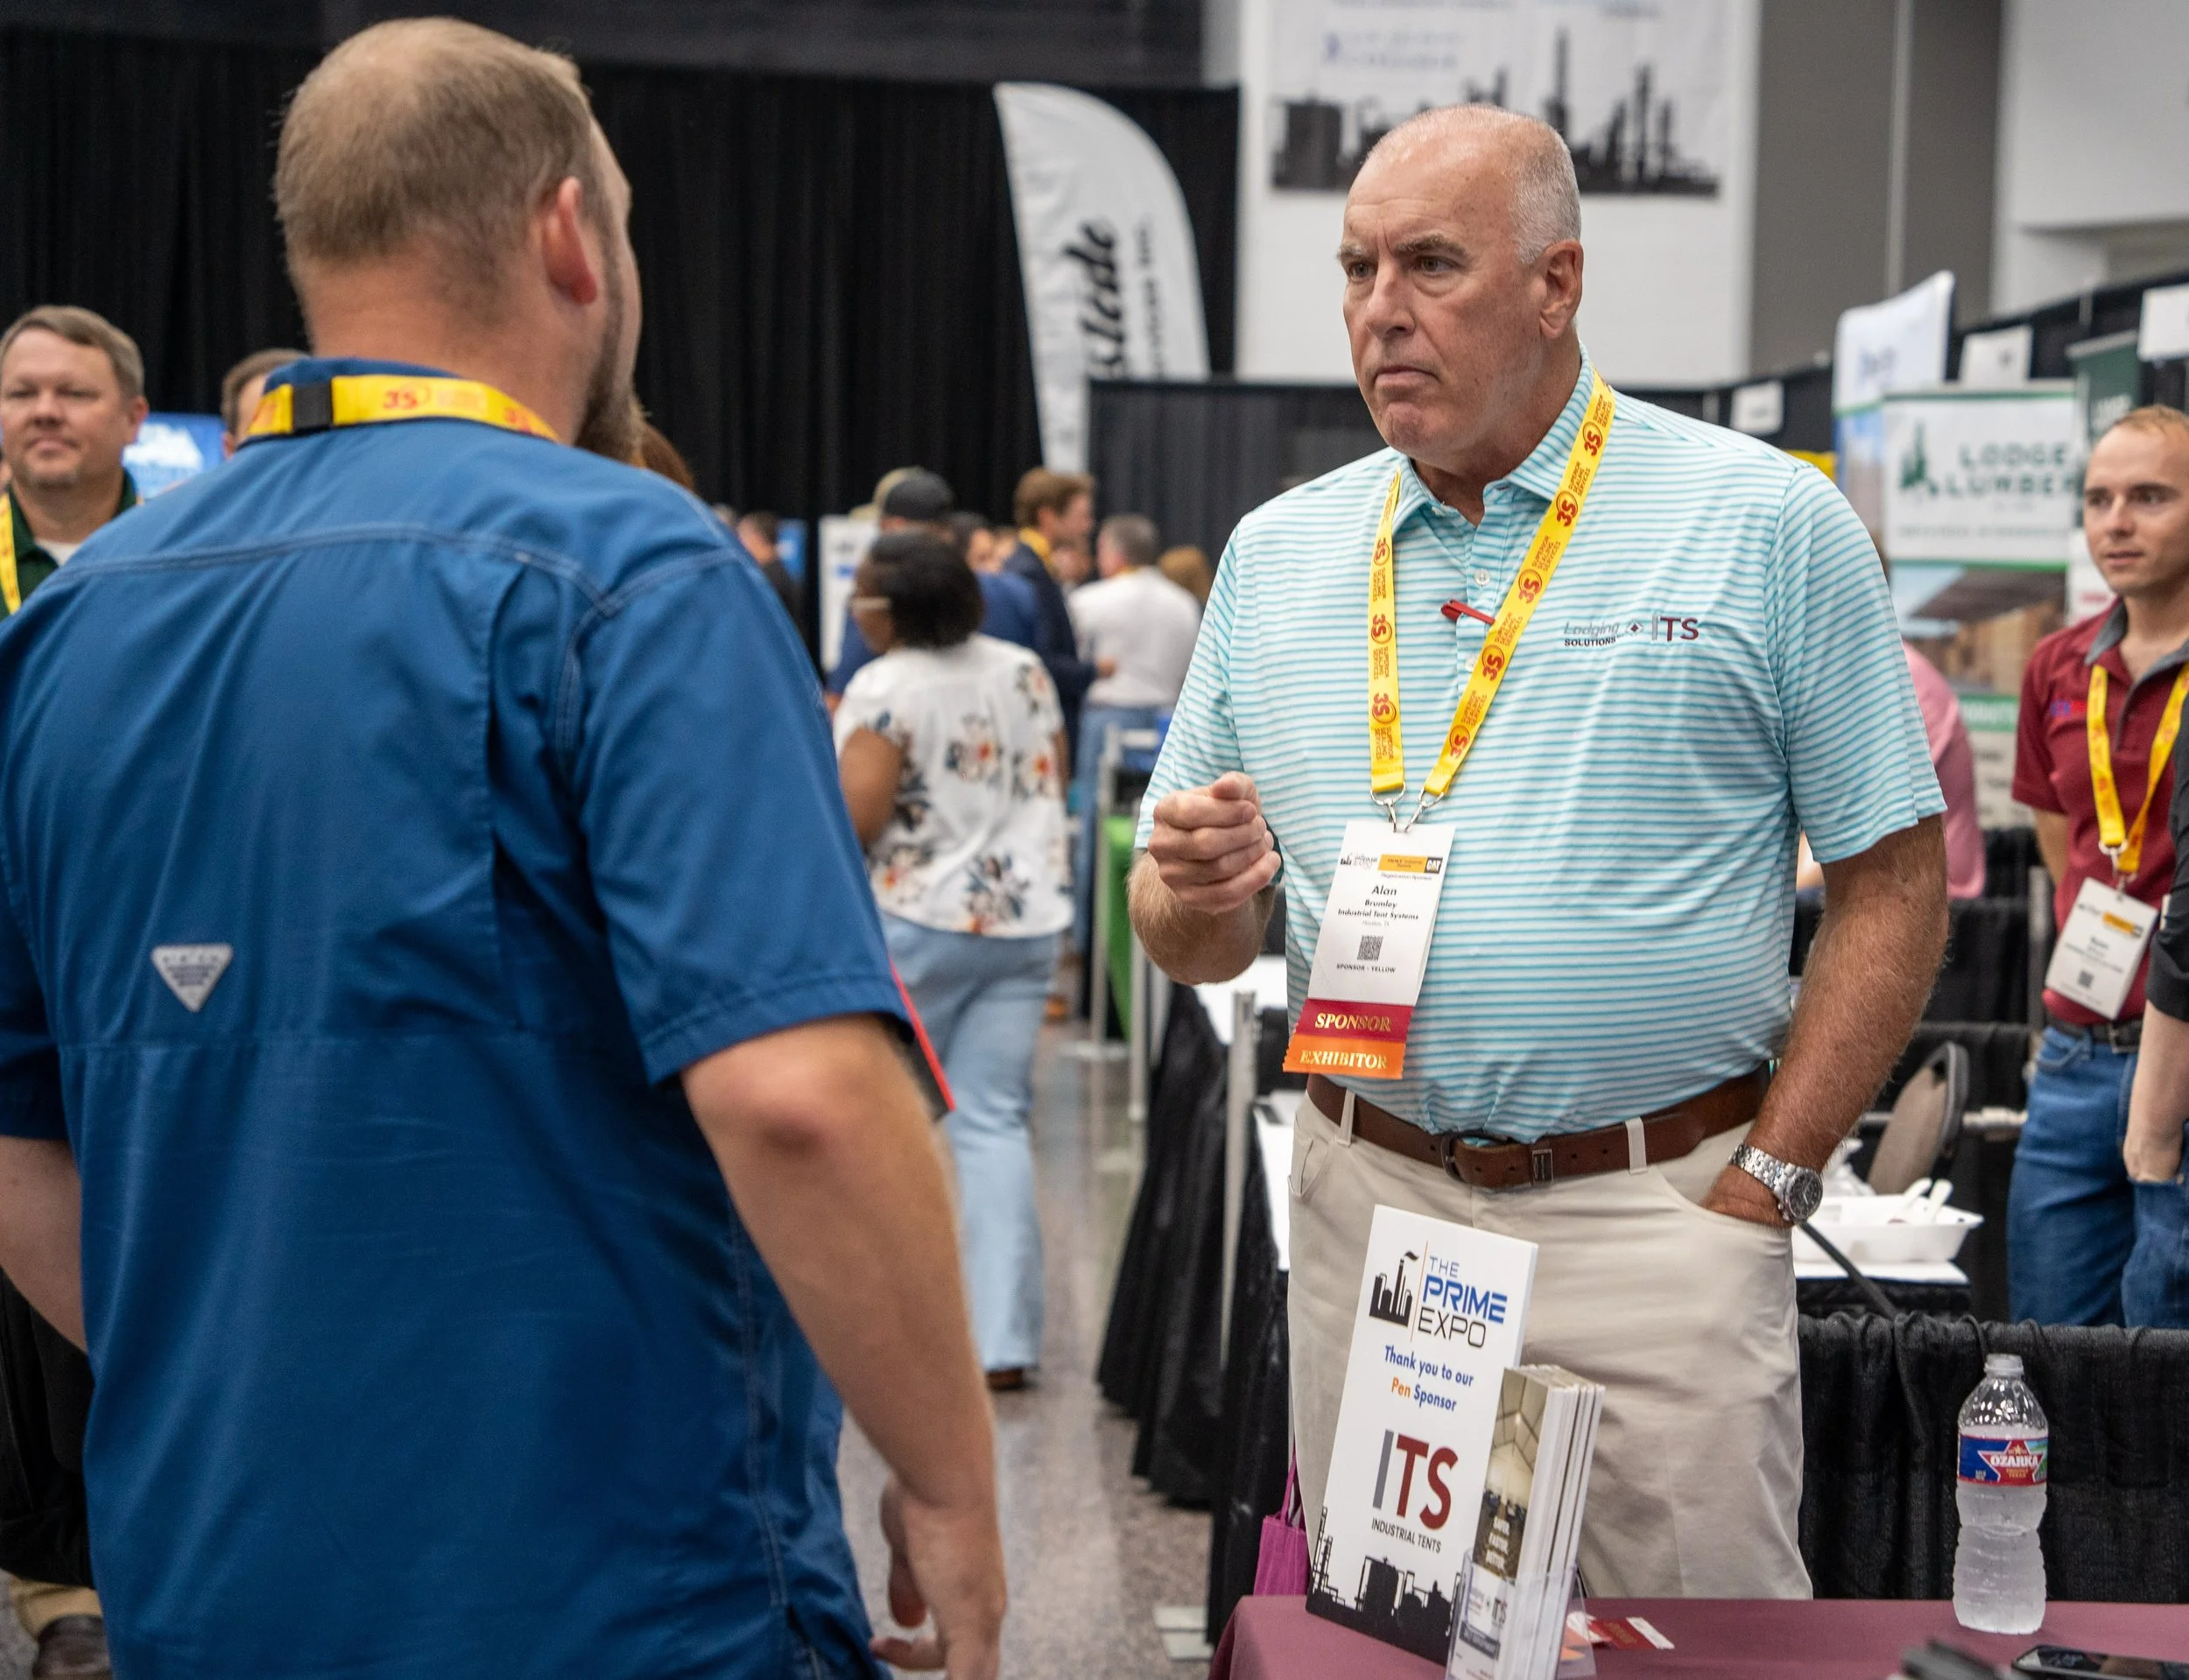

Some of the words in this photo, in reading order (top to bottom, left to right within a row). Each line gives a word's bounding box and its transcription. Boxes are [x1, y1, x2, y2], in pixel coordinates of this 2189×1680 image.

[1584, 431, 1601, 456] 3S
[1557, 500, 1577, 527] 3S
[1518, 578, 1540, 604] 3S
[1372, 614, 1387, 637] 3S
[1564, 621, 1620, 637] Lodging
[1652, 615, 1700, 642] ITS
[1564, 636, 1616, 646] SOLUTIONS
[1482, 654, 1503, 681] 3S
[1373, 692, 1390, 717] 3S
[1450, 735, 1468, 759] 3S
[1426, 858, 1440, 870] CAT
[1371, 885, 1397, 896] Alan
[1338, 908, 1371, 917] Industrial
[1390, 911, 1419, 921] Systems
[1364, 898, 1397, 910] Brumley
[1336, 963, 1365, 972] SPONSOR
[1314, 1012, 1392, 1033] SPONSOR
[1299, 1050, 1388, 1070] EXHIBITOR
[1429, 1255, 1460, 1278] THE
[1423, 1275, 1508, 1325] PRIME
[1418, 1305, 1487, 1349] EXPO
[1385, 1345, 1416, 1370] Thank
[1418, 1360, 1439, 1378] you
[1441, 1363, 1453, 1381] to
[1455, 1371, 1475, 1387] our
[1391, 1376, 1411, 1398] Pen
[1413, 1383, 1457, 1411] Sponsor
[1990, 1454, 2038, 1467] OZARKA
[1372, 1429, 1459, 1530] ITS
[1371, 1517, 1415, 1545] INDUSTRIAL
[1418, 1533, 1441, 1554] TENTS
